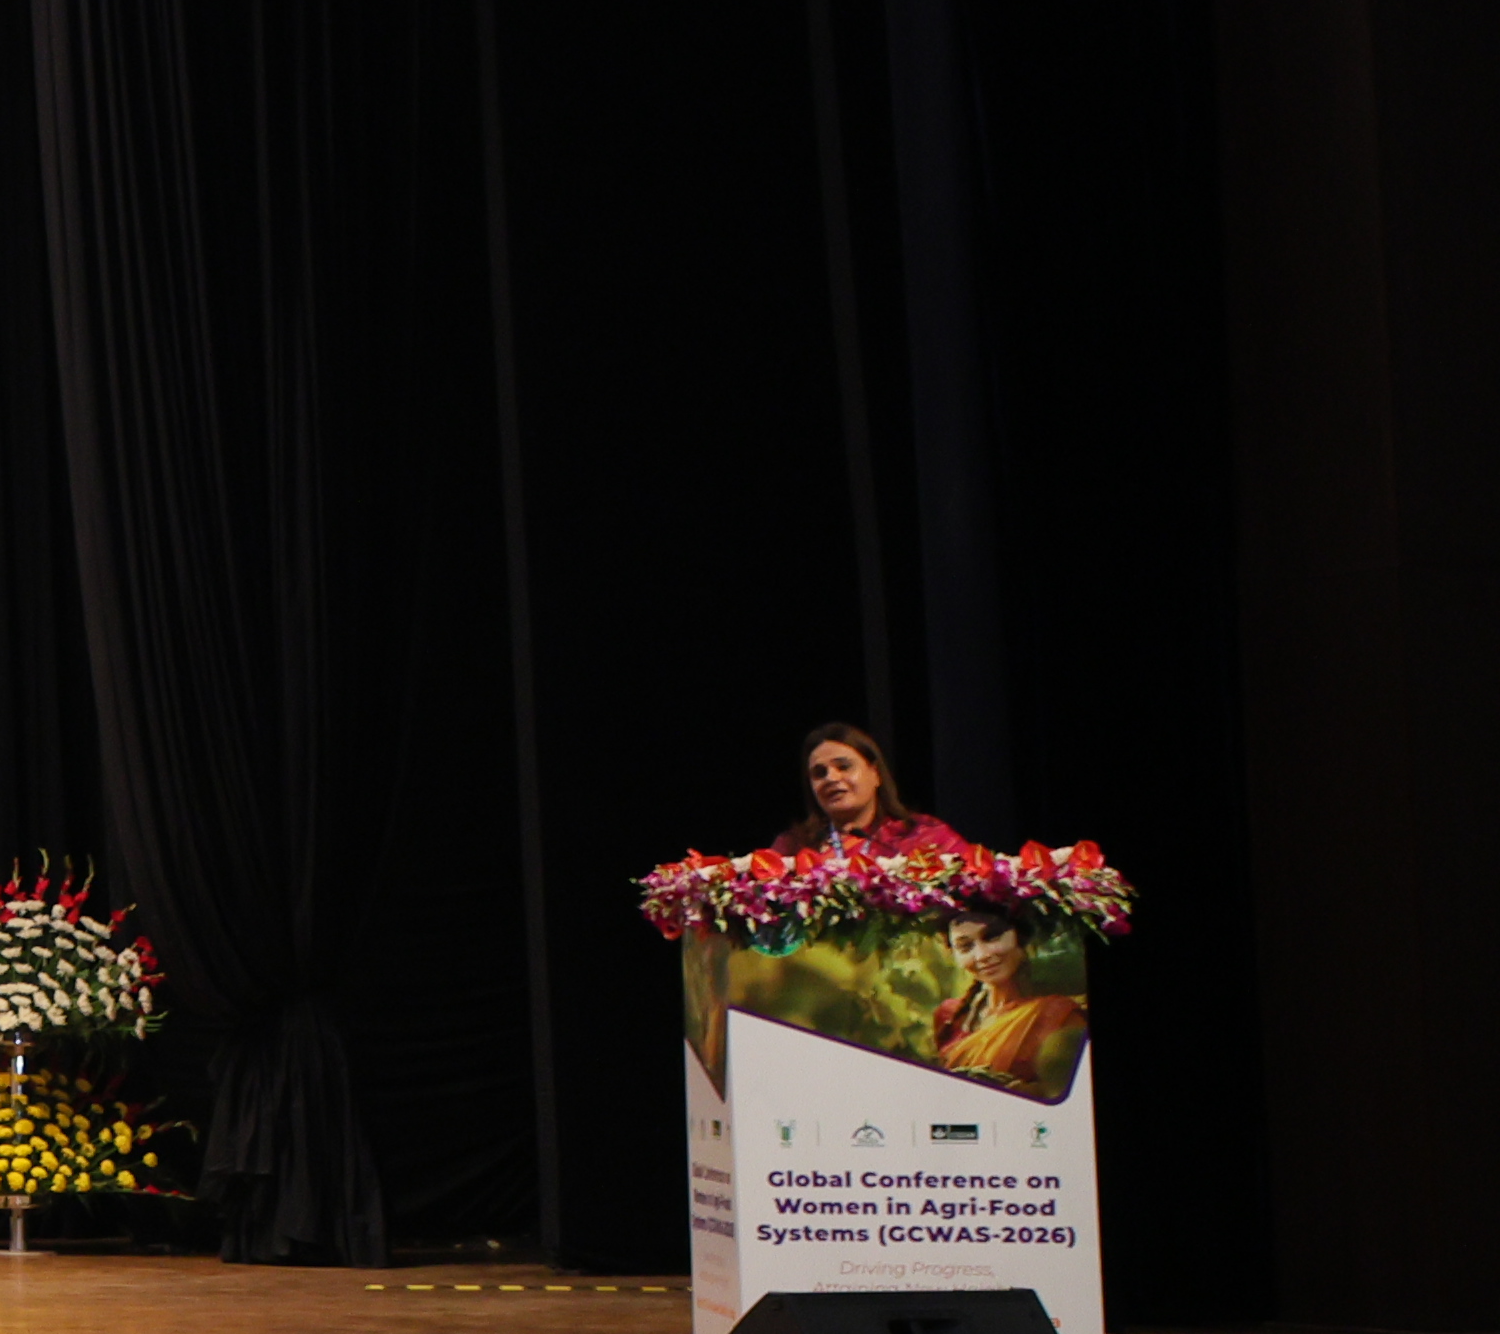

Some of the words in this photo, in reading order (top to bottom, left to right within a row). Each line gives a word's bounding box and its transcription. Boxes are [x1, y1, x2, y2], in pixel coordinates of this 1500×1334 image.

[768, 1171, 851, 1187] Global
[860, 1171, 1017, 1188] Conference
[1027, 1176, 1060, 1189] on
[774, 1198, 877, 1214] Women
[887, 1197, 911, 1215] in
[921, 1197, 1055, 1219] Agri-Food
[757, 1225, 869, 1245] Systems
[879, 1225, 1076, 1248] (GCWAS-2026)
